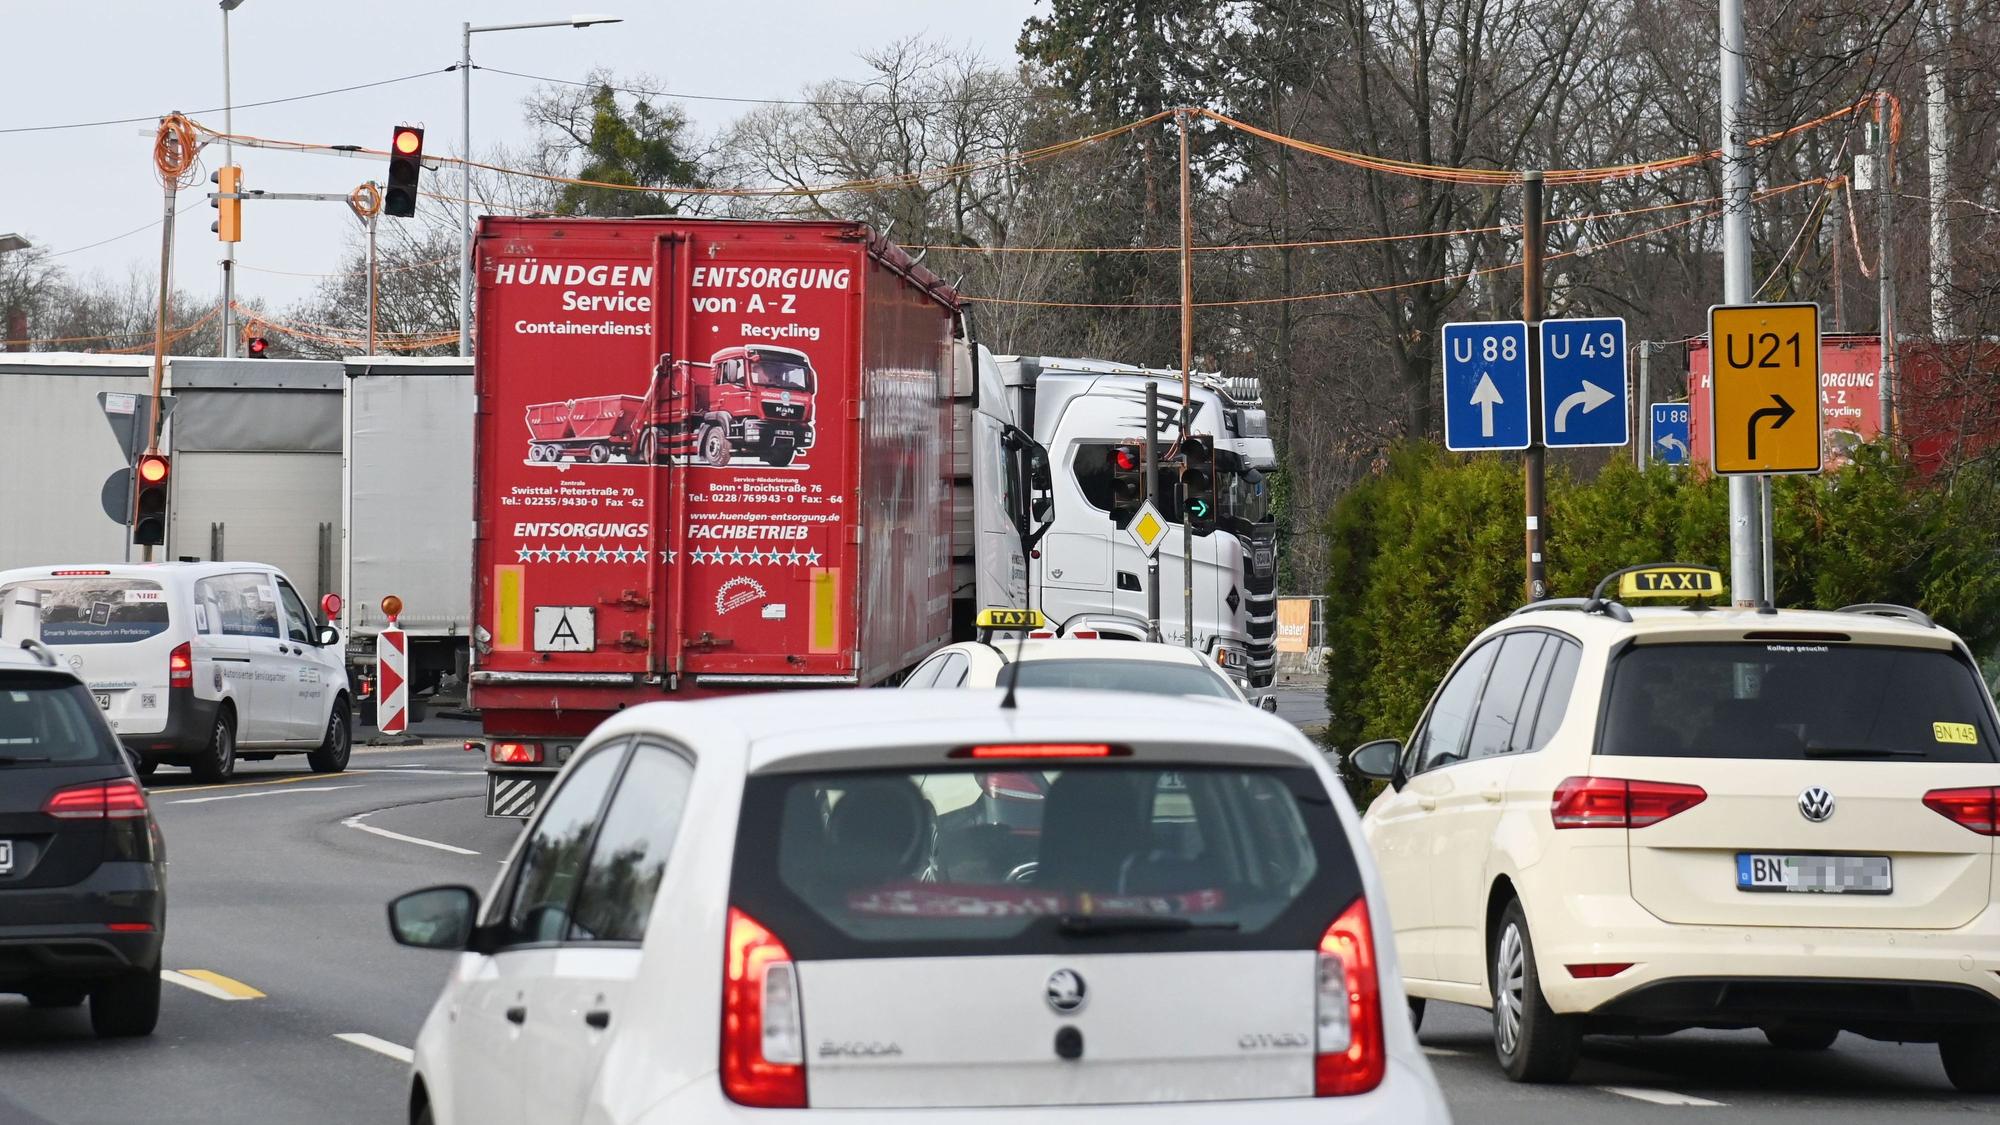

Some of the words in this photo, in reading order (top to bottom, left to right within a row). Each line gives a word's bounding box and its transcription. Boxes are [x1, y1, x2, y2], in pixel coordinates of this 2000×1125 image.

[495, 258, 653, 286] HÜNDGEN
[691, 267, 850, 289] ENTSORGUNG
[562, 290, 652, 312] Service
[692, 297, 736, 313] von
[514, 320, 652, 336] Containerdienst
[741, 323, 820, 341] Recycling
[1453, 337, 1472, 363] U
[1482, 335, 1517, 362] 88
[1551, 333, 1570, 360] U
[1580, 332, 1616, 358] 49
[1726, 332, 1800, 369] U21
[1656, 410, 1666, 423] U
[1670, 410, 1688, 423] 88
[1823, 405, 1862, 418] ecycling
[511, 486, 553, 495] Swisttal
[560, 487, 619, 496] Peterstraße
[622, 488, 634, 496] 70
[709, 483, 736, 492] Bonn
[743, 484, 807, 493] Broichstraße
[810, 485, 822, 493] 76
[501, 496, 521, 506] Tel.:
[605, 498, 624, 507] Fax
[688, 493, 709, 502] Tel.:
[801, 495, 823, 504] Fax:
[690, 511, 841, 523] www.huendgen-entsorgung.de
[513, 522, 649, 538] ENTSORGUNGS
[688, 525, 809, 540] FACHBETRIEB
[1643, 573, 1703, 590] TAXI
[992, 612, 1035, 624] TAXI
[548, 615, 579, 646] A
[1935, 725, 1953, 739] BN
[1956, 727, 1975, 741] 145
[1753, 858, 1782, 882] BN
